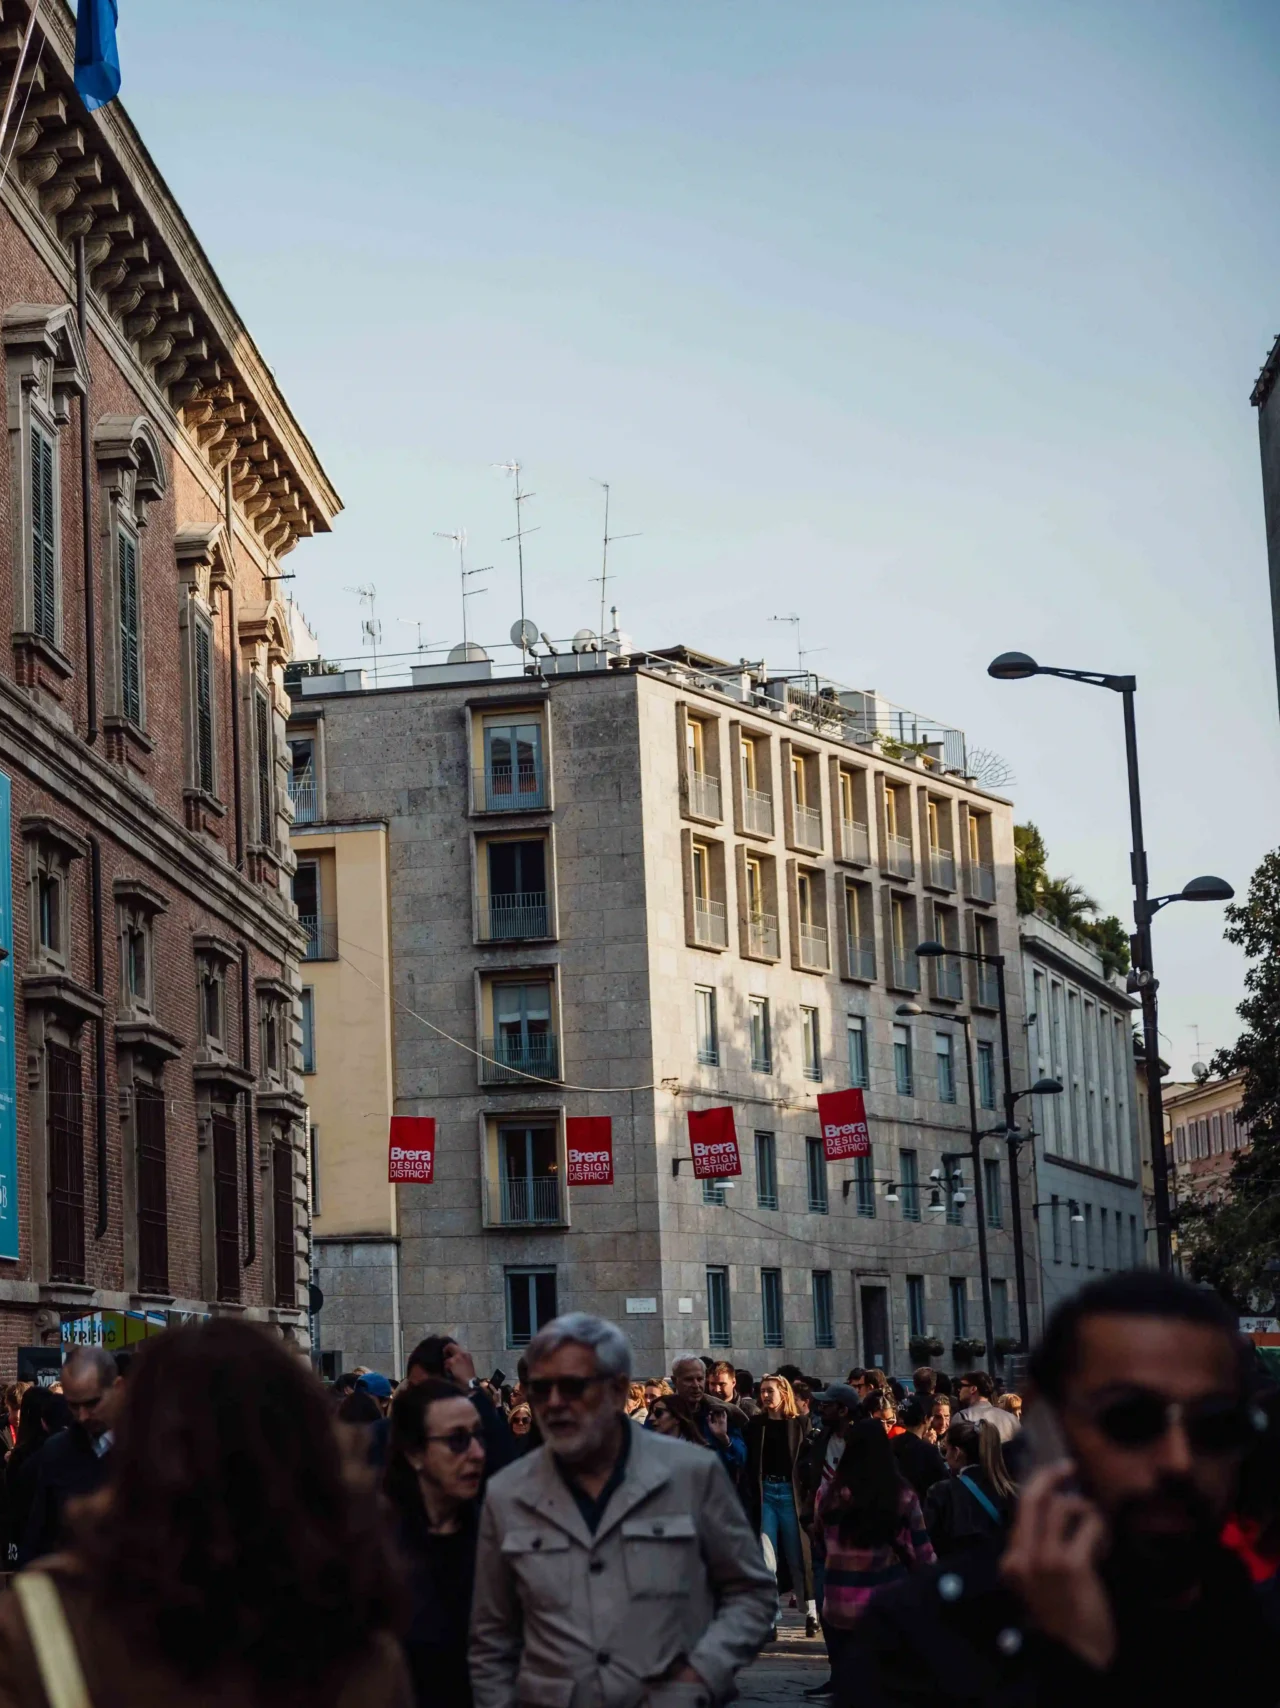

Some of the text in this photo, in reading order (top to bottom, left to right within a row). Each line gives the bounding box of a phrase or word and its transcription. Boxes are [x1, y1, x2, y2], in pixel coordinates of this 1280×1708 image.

[824, 1122, 866, 1138] Brera
[826, 1133, 868, 1147] DESIGN
[391, 1147, 431, 1161] Brera
[693, 1142, 735, 1157] Brera
[827, 1142, 868, 1155] DISTRICT
[568, 1149, 609, 1162] Brera
[695, 1153, 737, 1166] DESIGN
[390, 1161, 431, 1170] DESIGN
[569, 1163, 610, 1172] DESIGN
[696, 1162, 738, 1175] DISTRICT
[390, 1170, 430, 1178] DISTRICT
[569, 1171, 609, 1181] DISTRICT
[60, 1330, 116, 1344] BYREDO
